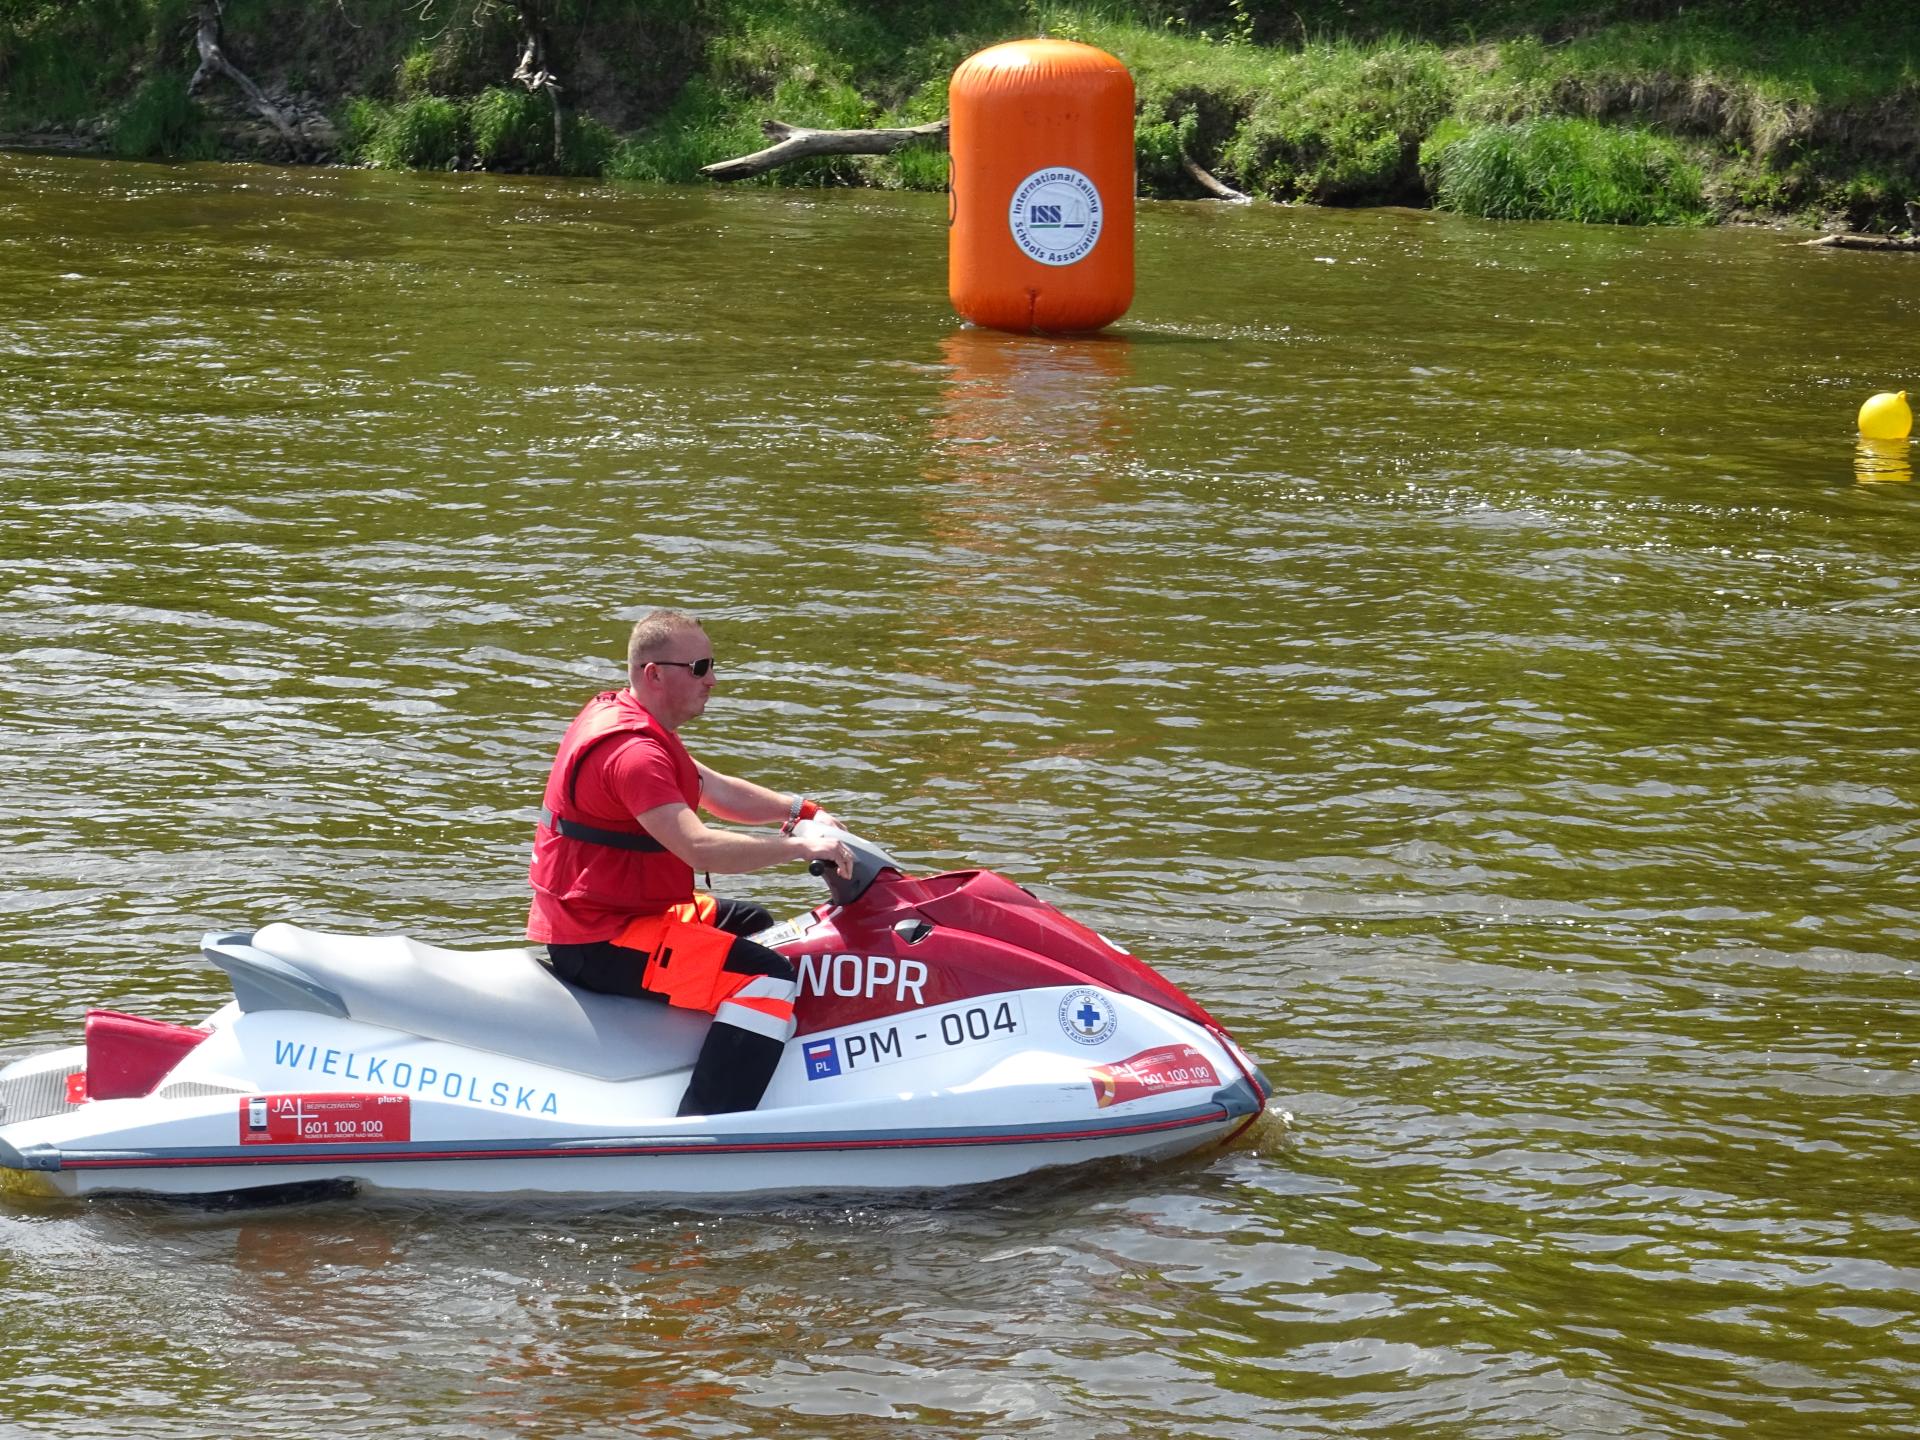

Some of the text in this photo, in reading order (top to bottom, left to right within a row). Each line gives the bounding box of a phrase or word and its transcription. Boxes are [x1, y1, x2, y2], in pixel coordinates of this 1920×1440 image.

[1013, 173, 1099, 214] International Sailing
[1031, 205, 1062, 223] ISS
[1015, 221, 1099, 262] Schools Association
[844, 1027, 902, 1068] PM
[941, 1002, 1017, 1046] 004
[815, 1061, 831, 1073] PL
[1144, 1072, 1165, 1085] 601
[1167, 1068, 1188, 1081] 100
[1189, 1066, 1209, 1079] 100
[275, 1040, 558, 1115] WIELKOPOLSKA
[377, 1095, 397, 1105] plus
[304, 1120, 383, 1133] 601 100 100
